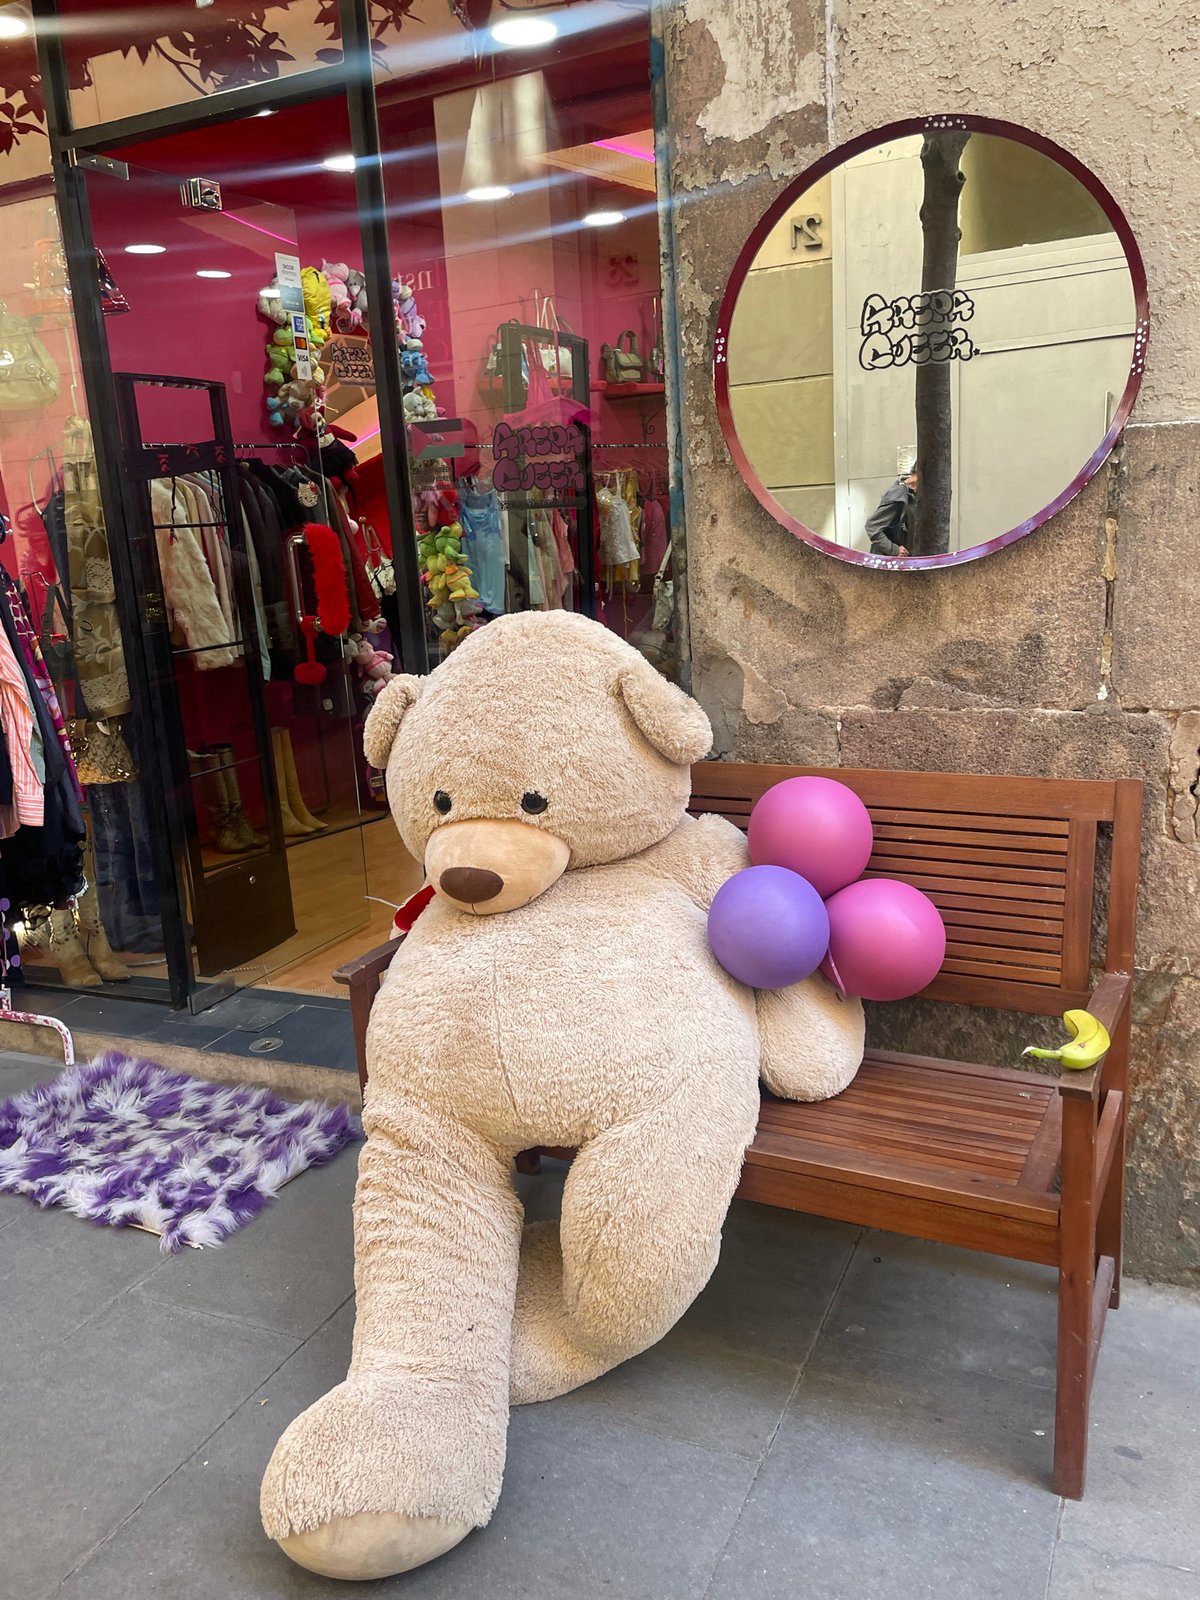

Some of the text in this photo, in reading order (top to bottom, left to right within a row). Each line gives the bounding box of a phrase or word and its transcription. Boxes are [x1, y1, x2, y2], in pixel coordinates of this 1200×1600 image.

[860, 290, 975, 336] AREPA
[297, 354, 309, 362] VISA
[493, 422, 586, 461] AREPA
